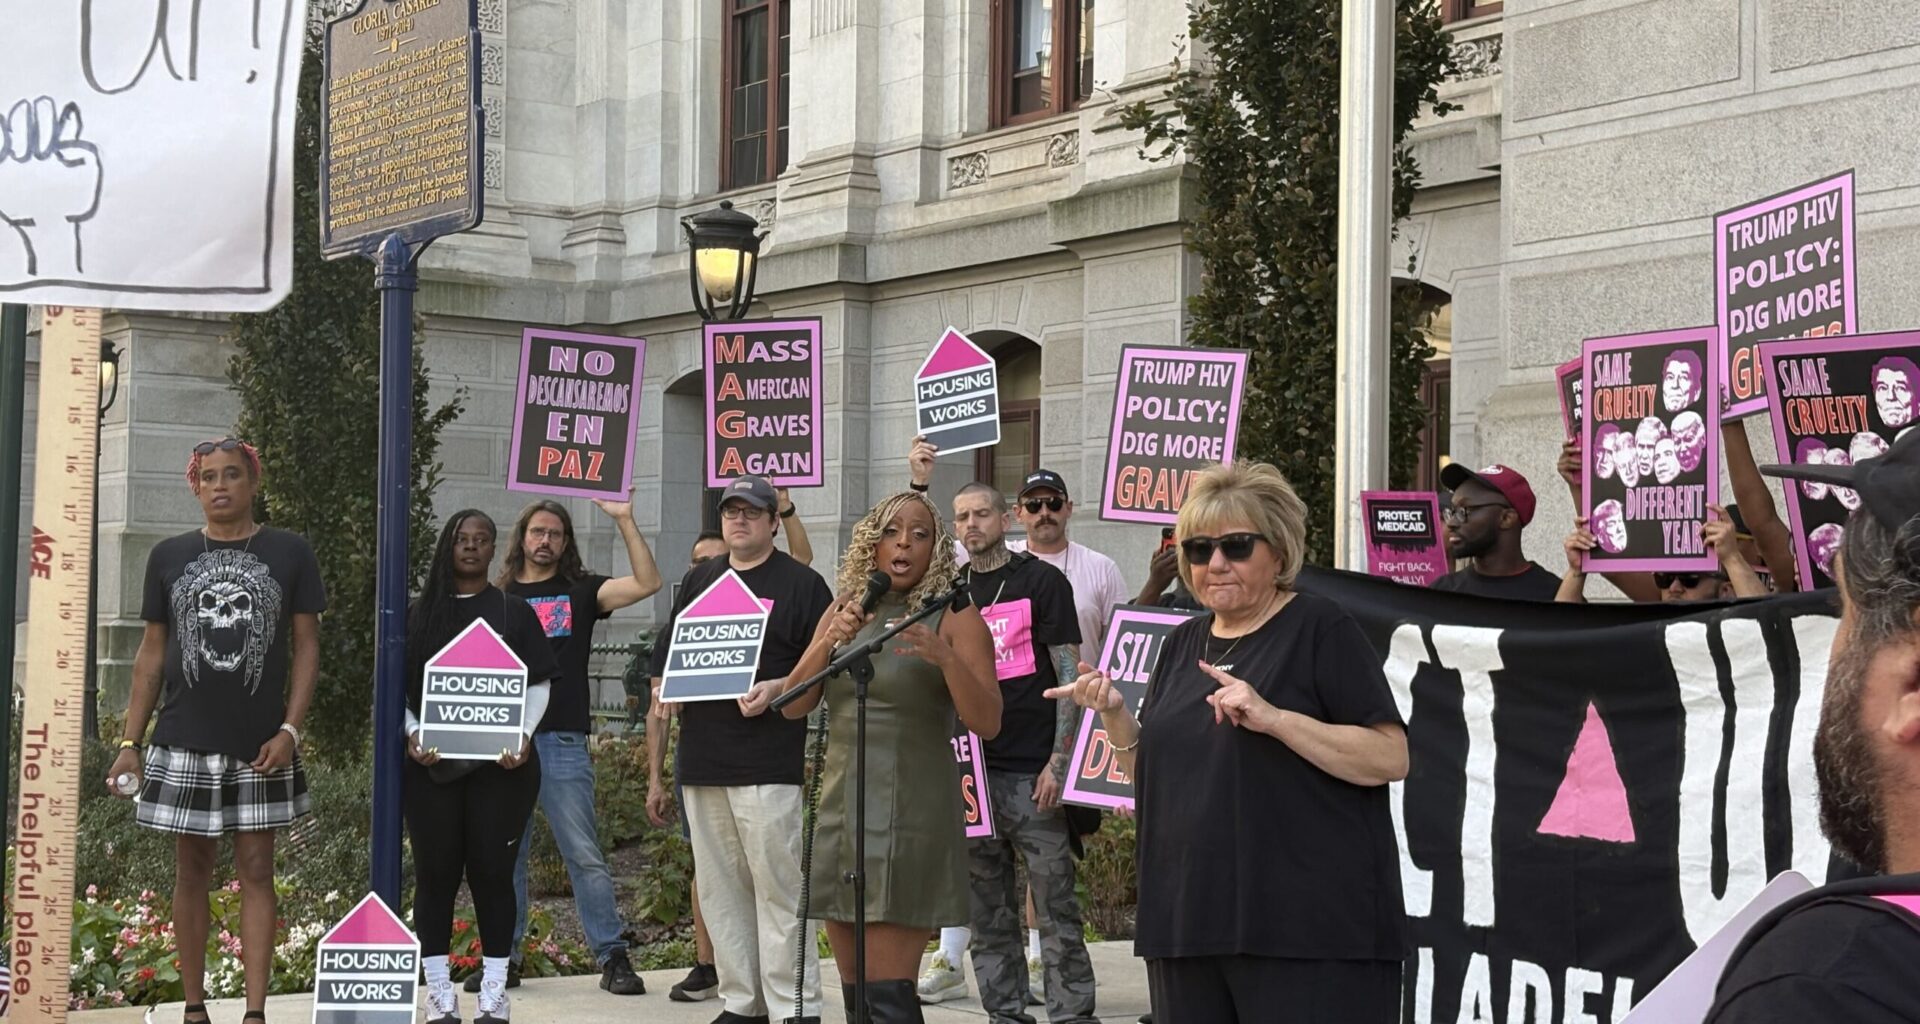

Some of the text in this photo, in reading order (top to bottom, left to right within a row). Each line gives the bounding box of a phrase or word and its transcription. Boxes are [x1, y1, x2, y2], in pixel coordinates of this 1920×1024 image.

[352, 8, 389, 35] GLORIA
[350, 67, 372, 83] lesbian
[389, 53, 410, 71] rights
[412, 45, 434, 62] leader
[437, 35, 466, 54] Casarez
[329, 51, 465, 104] started her career as an activist fighting
[329, 107, 338, 118] for
[340, 96, 369, 115] economic
[399, 79, 425, 95] welfare
[452, 63, 466, 78] and
[395, 97, 408, 111] She
[409, 91, 421, 106] led
[422, 89, 433, 102] the
[435, 85, 451, 98] Gay
[452, 77, 466, 93] and
[329, 128, 352, 145] Lesbian
[354, 121, 375, 137] Latino
[377, 112, 394, 130] AIDS
[396, 104, 430, 125] Education
[432, 110, 466, 131] programs
[329, 124, 466, 173] serving men of color and transgender
[345, 179, 371, 196] director
[373, 175, 380, 189] of
[382, 169, 400, 186] LGBT
[431, 157, 452, 173] Under
[454, 153, 466, 166] her
[354, 167, 365, 179] She
[367, 165, 379, 176] was
[381, 151, 415, 174] appointed
[365, 192, 376, 205] the
[377, 188, 391, 203] city
[392, 179, 420, 198] adopted
[422, 176, 433, 190] the
[435, 166, 466, 187] broadest
[329, 211, 365, 232] protections
[374, 204, 384, 217] the
[386, 199, 407, 214] nation
[409, 195, 418, 208] for
[421, 188, 439, 205] LGBT
[1729, 192, 1839, 251] TRUMP HIV
[1729, 238, 1841, 294] POLICY:
[1730, 279, 1842, 337] DIG MORE
[549, 346, 615, 376] NO
[715, 335, 809, 364] MASS
[70, 357, 84, 375] 14
[1133, 360, 1233, 387] TRUMP HIV
[1594, 352, 1632, 388] SAME
[1778, 357, 1831, 397] SAME
[528, 375, 630, 414] DESCANSAREMOS
[717, 372, 810, 401] AMERICAN
[919, 372, 992, 400] HOUSING
[68, 406, 81, 425] 15
[929, 399, 987, 424] WORKS
[1126, 396, 1227, 424] POLICY:
[1594, 384, 1657, 421] CRUELTY
[1786, 395, 1869, 436] CRUELTY
[546, 411, 604, 445] EN
[716, 410, 810, 439] GRAVES
[1121, 431, 1223, 461] DIG MORE
[66, 455, 79, 474] 16
[537, 446, 605, 482] PAZ
[718, 447, 811, 476] AGAIN
[63, 504, 76, 523] 17
[1378, 510, 1422, 521] PROTECT
[1626, 484, 1704, 520] DIFFERENT
[1377, 521, 1426, 532] MEDICAID
[1662, 520, 1704, 554] YEAR
[31, 525, 56, 580] ACE
[61, 552, 75, 572] 18
[1378, 562, 1405, 572] FIGHT
[59, 601, 72, 621] 19
[677, 623, 759, 643] HOUSING
[56, 650, 69, 669] 20
[682, 650, 745, 667] WORKS
[1111, 631, 1165, 684] SIL
[430, 674, 521, 694] HOUSING
[53, 699, 67, 717] 21
[438, 705, 510, 723] WORKS
[51, 749, 65, 768] 22
[48, 797, 62, 817] 23
[12, 723, 48, 1004] The helpful place.
[46, 847, 60, 866] 24
[44, 896, 57, 916] 25
[41, 945, 55, 965] 26
[323, 952, 413, 970] HOUSING
[39, 995, 53, 1014] 27
[330, 983, 402, 1000] WORKS
